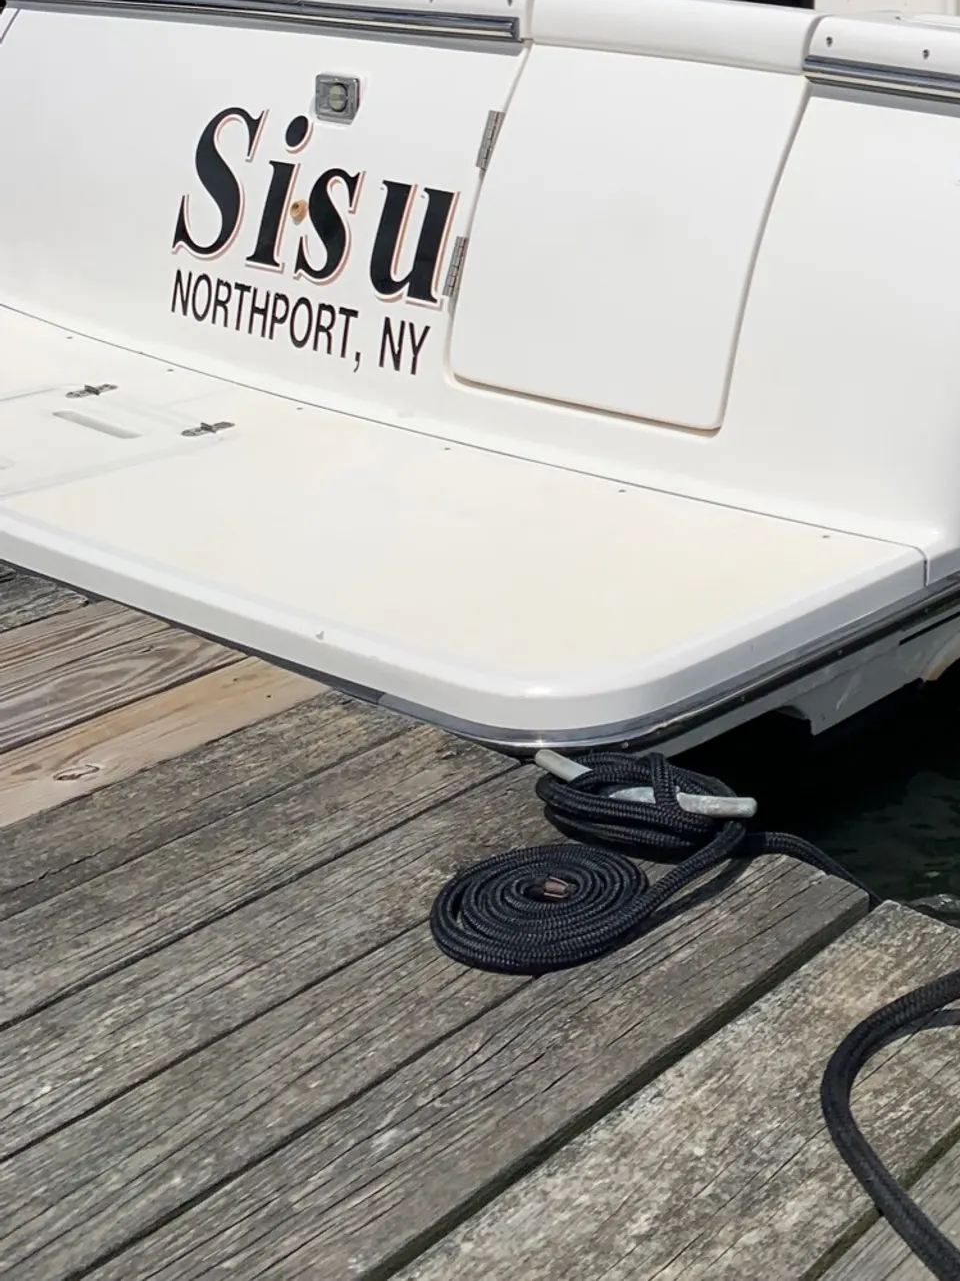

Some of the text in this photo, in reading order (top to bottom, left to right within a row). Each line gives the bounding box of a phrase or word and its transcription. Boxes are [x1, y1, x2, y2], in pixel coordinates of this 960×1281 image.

[171, 107, 461, 311] Sisu
[171, 269, 431, 376] NORTHPORT, NY
